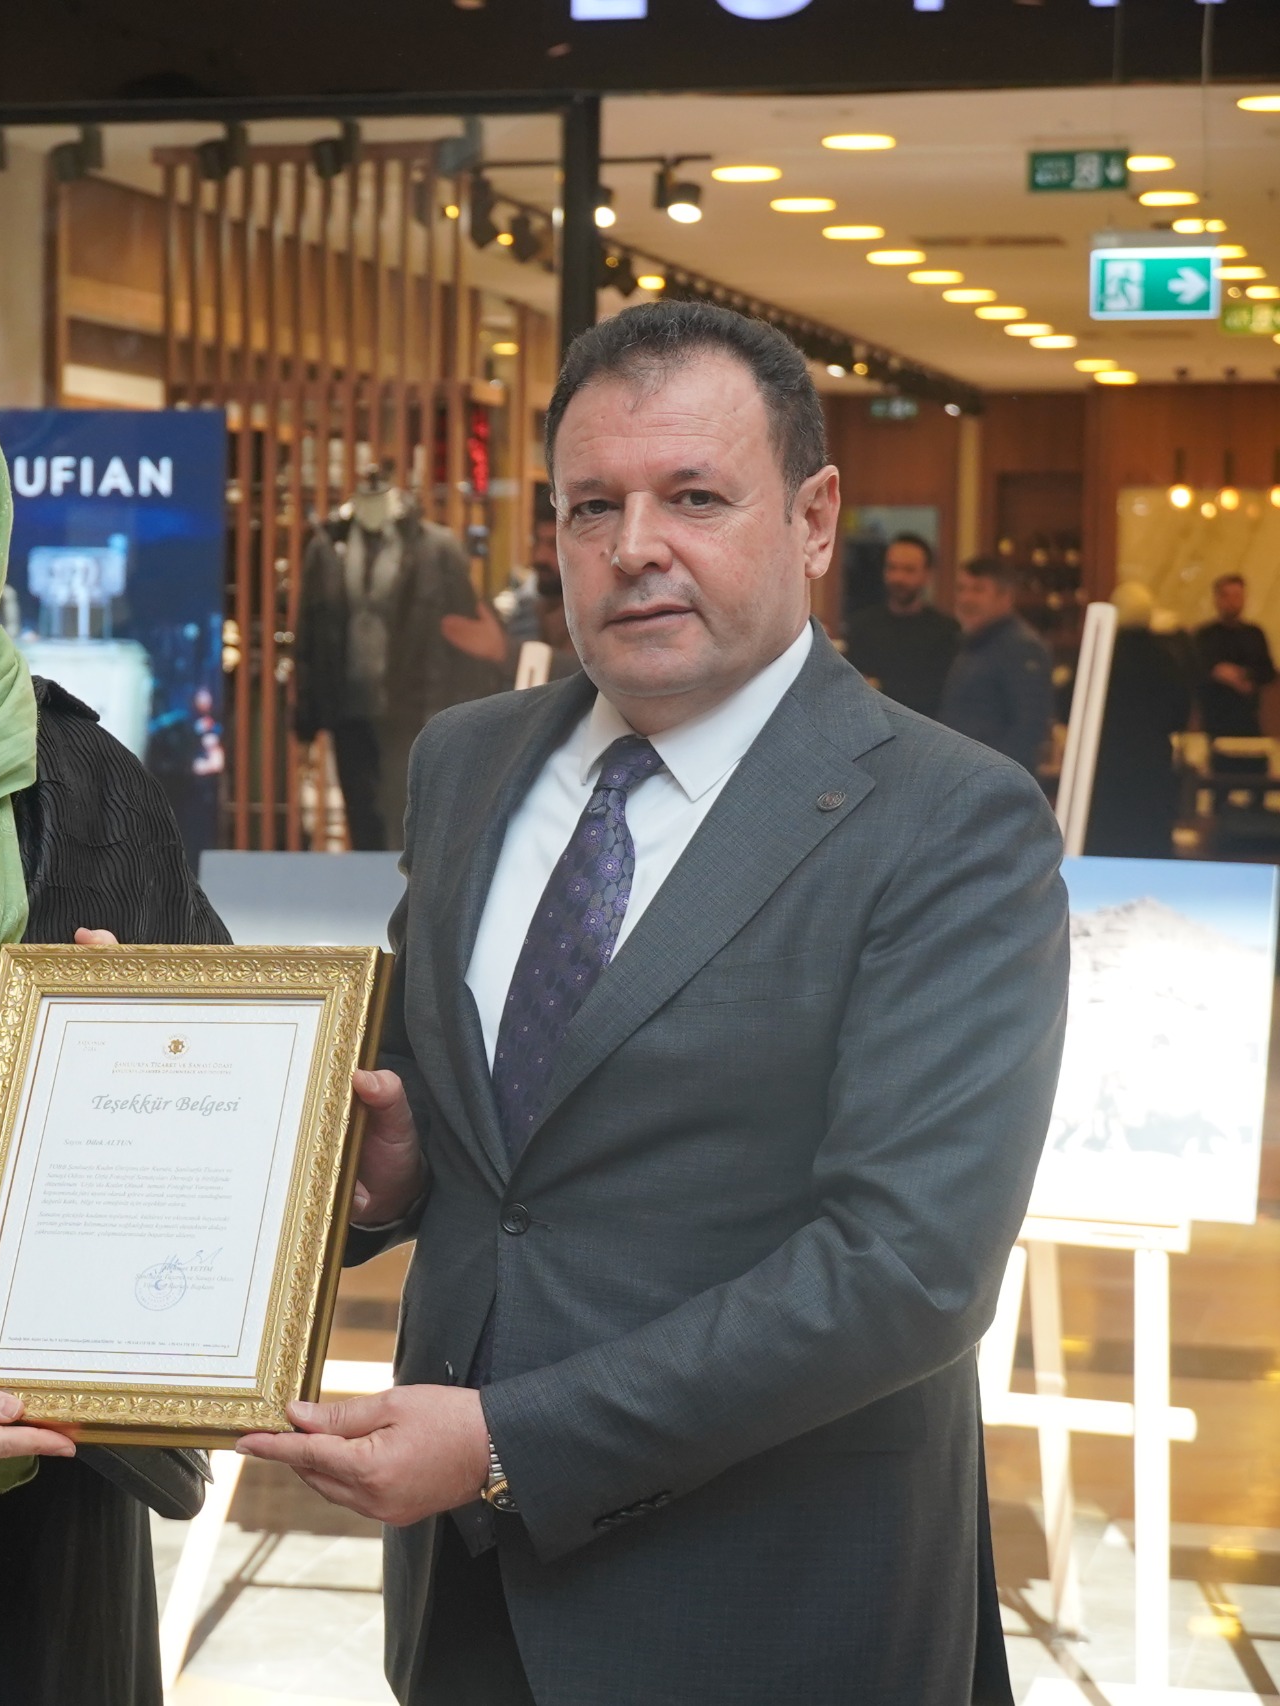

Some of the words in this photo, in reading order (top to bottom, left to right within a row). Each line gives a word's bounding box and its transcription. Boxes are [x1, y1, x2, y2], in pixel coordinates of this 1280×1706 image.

[13, 455, 173, 498] UFIAN
[91, 1093, 173, 1114] Teşekkür
[176, 1095, 242, 1116] Belgesi
